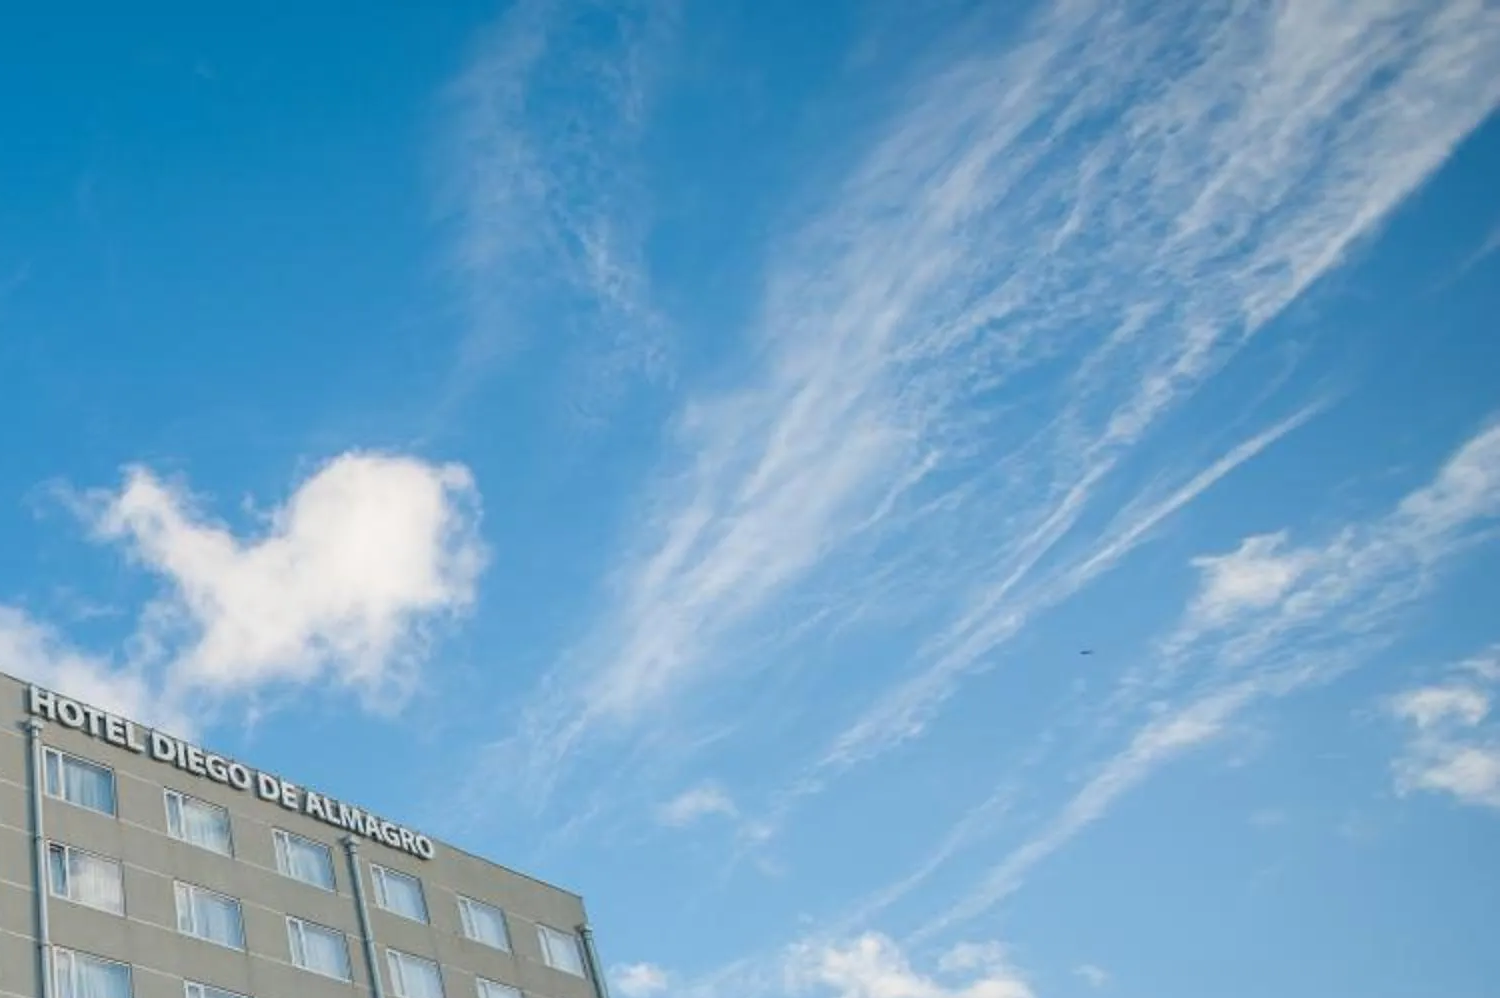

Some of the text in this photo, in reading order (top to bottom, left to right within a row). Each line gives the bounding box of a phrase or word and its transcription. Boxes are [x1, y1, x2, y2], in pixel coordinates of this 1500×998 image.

[29, 684, 435, 860] HOTEL DIEGO DE ALMAGRO
